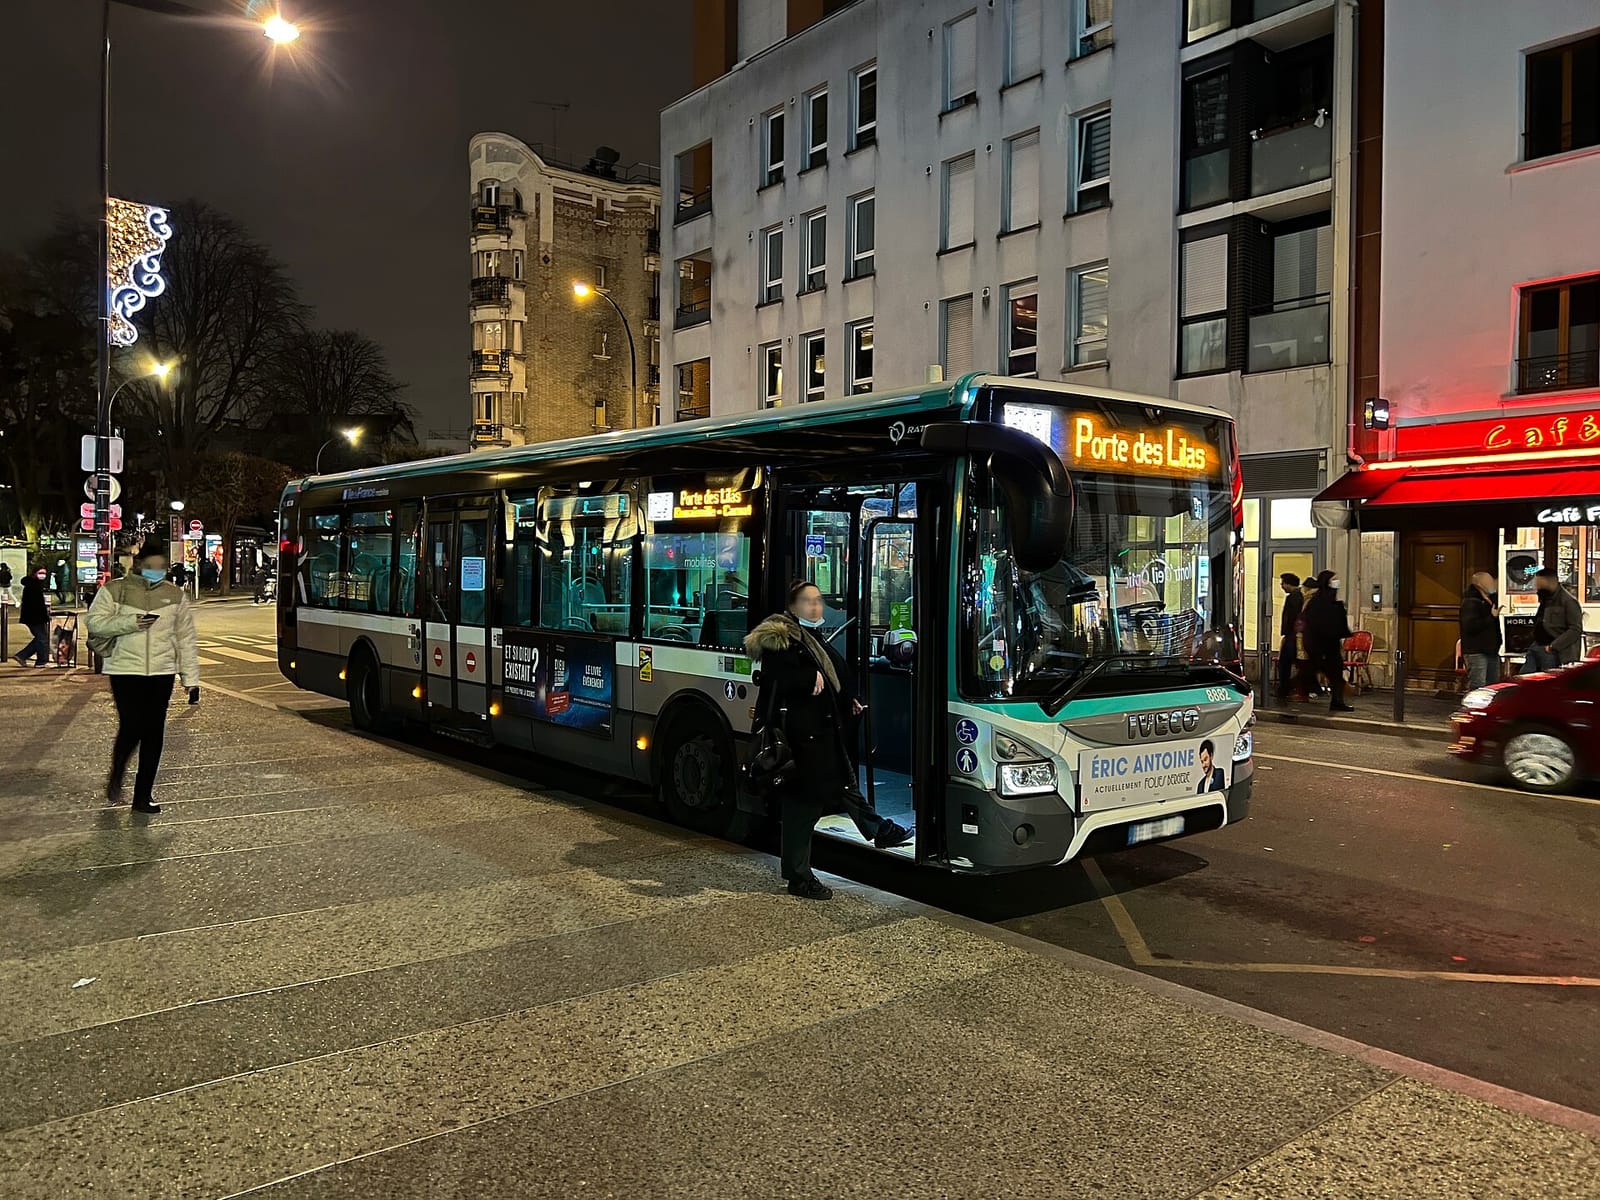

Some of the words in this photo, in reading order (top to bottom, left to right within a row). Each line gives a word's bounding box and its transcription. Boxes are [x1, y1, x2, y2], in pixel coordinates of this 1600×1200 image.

[907, 424, 926, 434] RAT
[1484, 415, 1600, 448] Café
[1075, 417, 1128, 462] Porte
[1133, 432, 1163, 465] des
[1166, 429, 1206, 470] Lilas
[680, 490, 703, 506] Porte
[703, 488, 719, 504] des
[720, 487, 742, 504] Lilas
[1537, 507, 1581, 523] Café
[505, 644, 511, 659] ET
[512, 645, 519, 661] SI
[519, 646, 531, 662] DIEU
[505, 662, 531, 682] EXISTAIT
[1205, 688, 1232, 702] 8882
[1128, 707, 1200, 740] IVECO
[1091, 754, 1129, 779] ÉRIC
[1132, 748, 1195, 774] ANTOINE
[1094, 782, 1142, 794] ACTUELLEMENT
